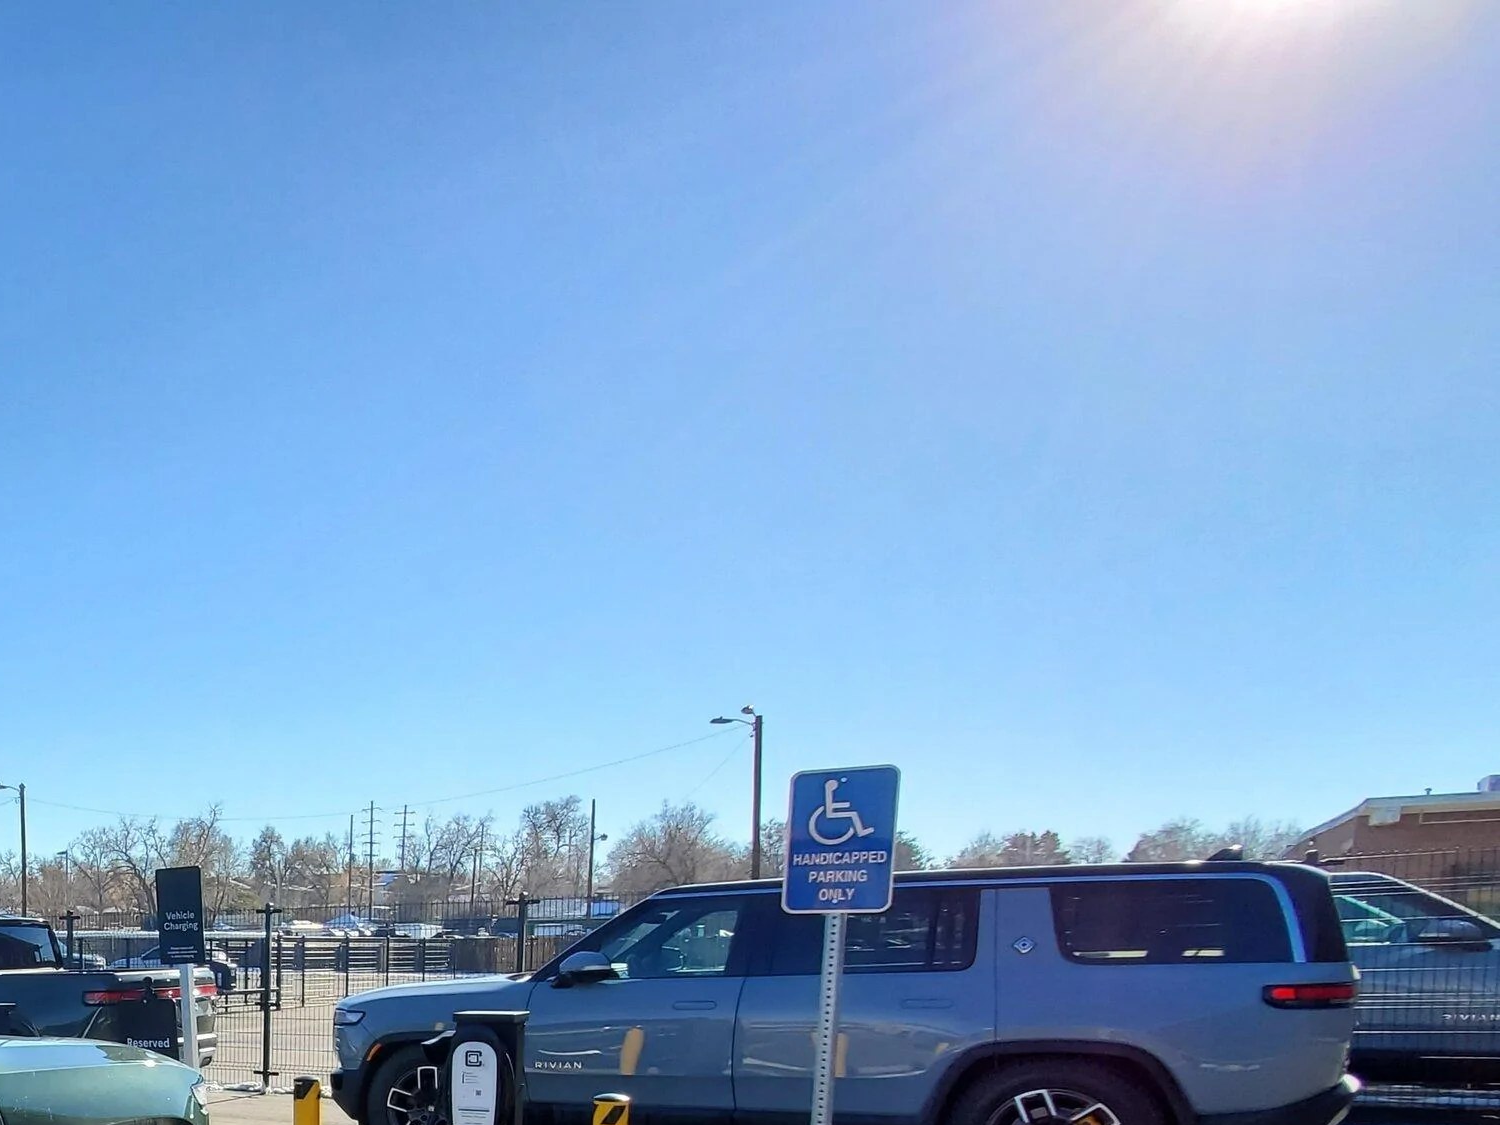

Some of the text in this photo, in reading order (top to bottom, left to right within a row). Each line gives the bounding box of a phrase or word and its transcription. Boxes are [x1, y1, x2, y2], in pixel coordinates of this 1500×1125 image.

[793, 851, 887, 866] HANDICAPPED
[808, 870, 868, 883] PARKING
[819, 888, 855, 901] ONLY
[165, 911, 195, 921] Vehicle
[163, 921, 199, 932] Charging
[126, 1038, 170, 1048] Reserved
[534, 1061, 583, 1070] RIVIAN
